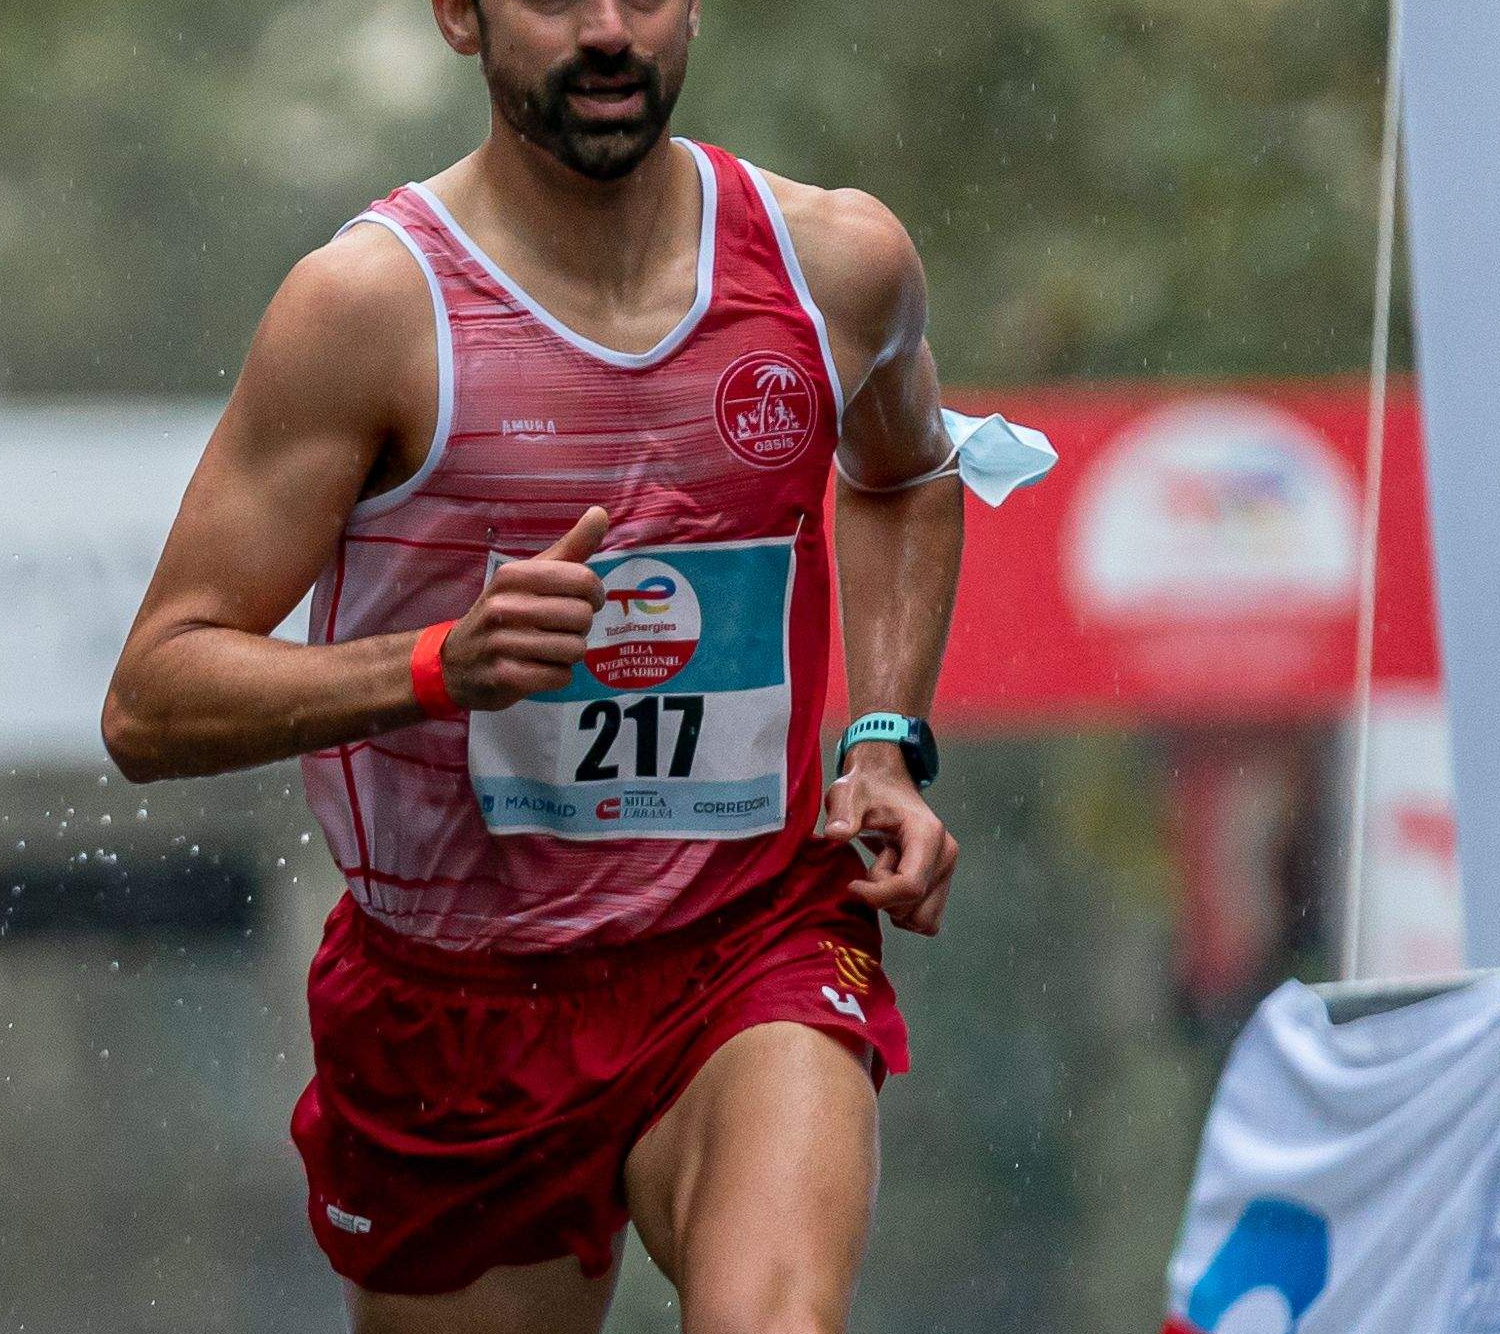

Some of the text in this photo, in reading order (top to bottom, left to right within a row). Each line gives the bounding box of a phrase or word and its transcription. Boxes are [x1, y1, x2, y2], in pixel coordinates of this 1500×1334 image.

[754, 435, 794, 453] oasis
[605, 621, 677, 636] TotalEnergies
[619, 644, 653, 656] MILLA
[596, 655, 682, 673] INTERNACIONAL
[608, 667, 668, 681] DE MADRID
[575, 695, 704, 782] 217
[505, 796, 577, 818] MADRID
[624, 796, 667, 807] MILLA
[623, 807, 673, 819] URBANA
